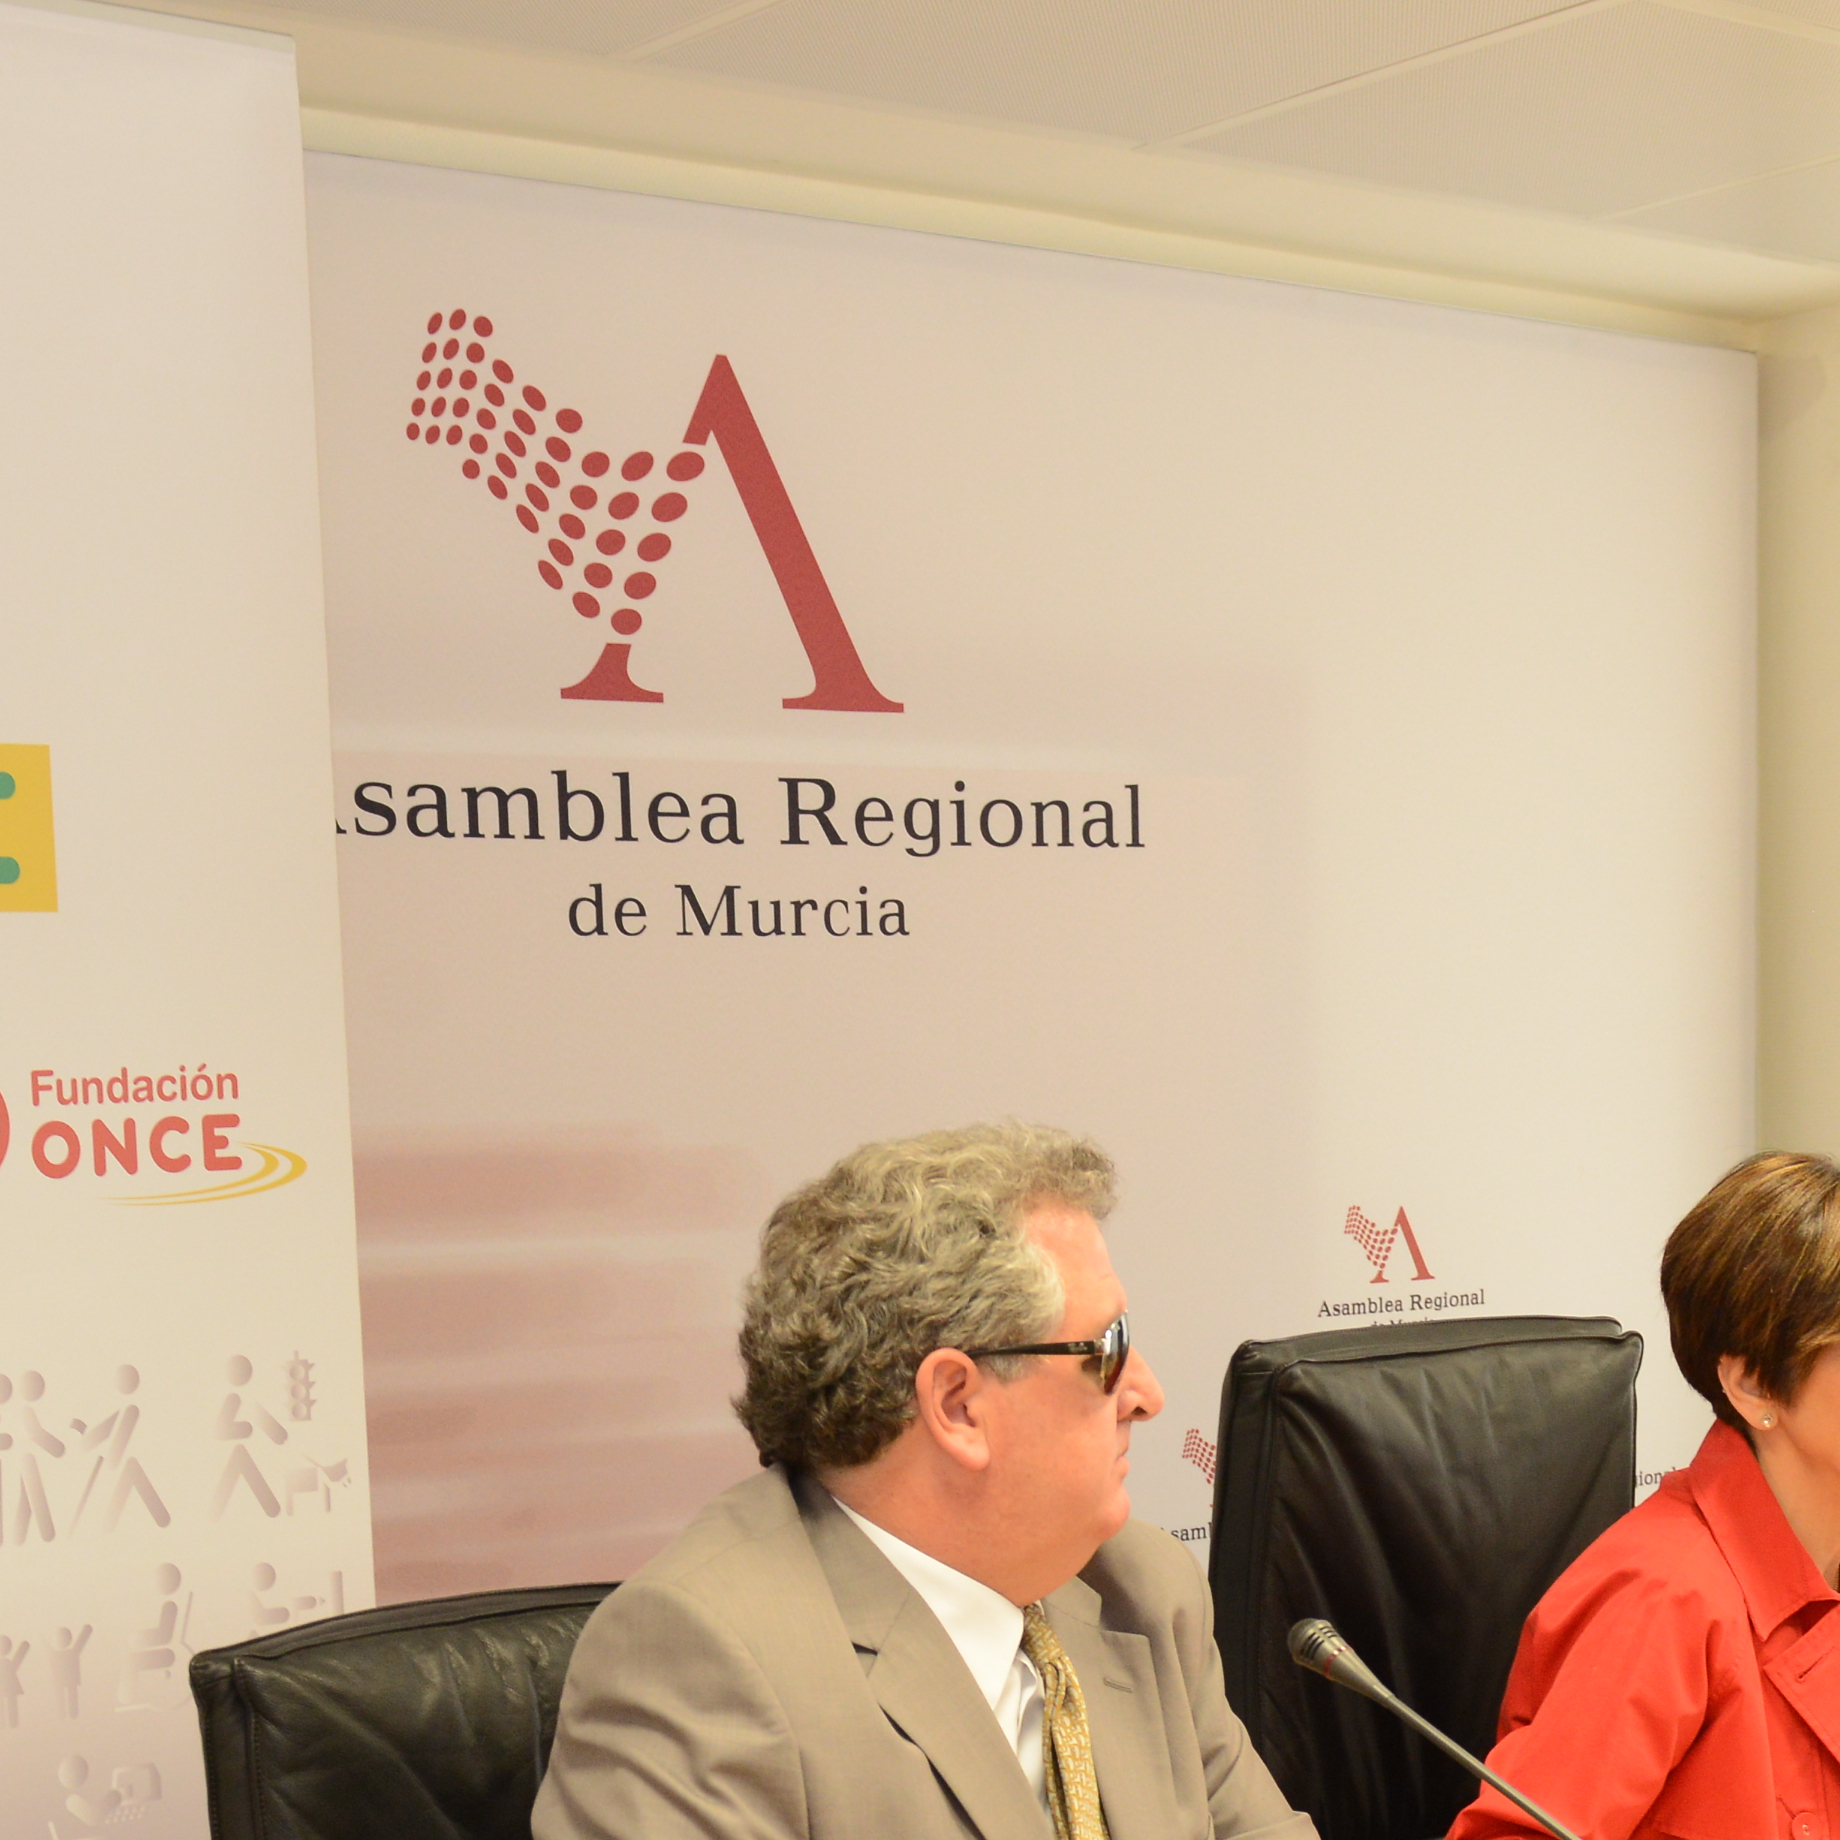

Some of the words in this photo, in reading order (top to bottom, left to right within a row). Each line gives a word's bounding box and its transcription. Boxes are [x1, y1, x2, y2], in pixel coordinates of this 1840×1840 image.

[336, 769, 744, 845] samblea
[778, 776, 1146, 858] Regional
[568, 883, 648, 938] de
[674, 884, 910, 938] Murcia
[30, 1063, 240, 1106] Fundación
[31, 1113, 243, 1179] ONCE
[1317, 1297, 1404, 1318] Asamblea
[1409, 1288, 1486, 1311] Regional
